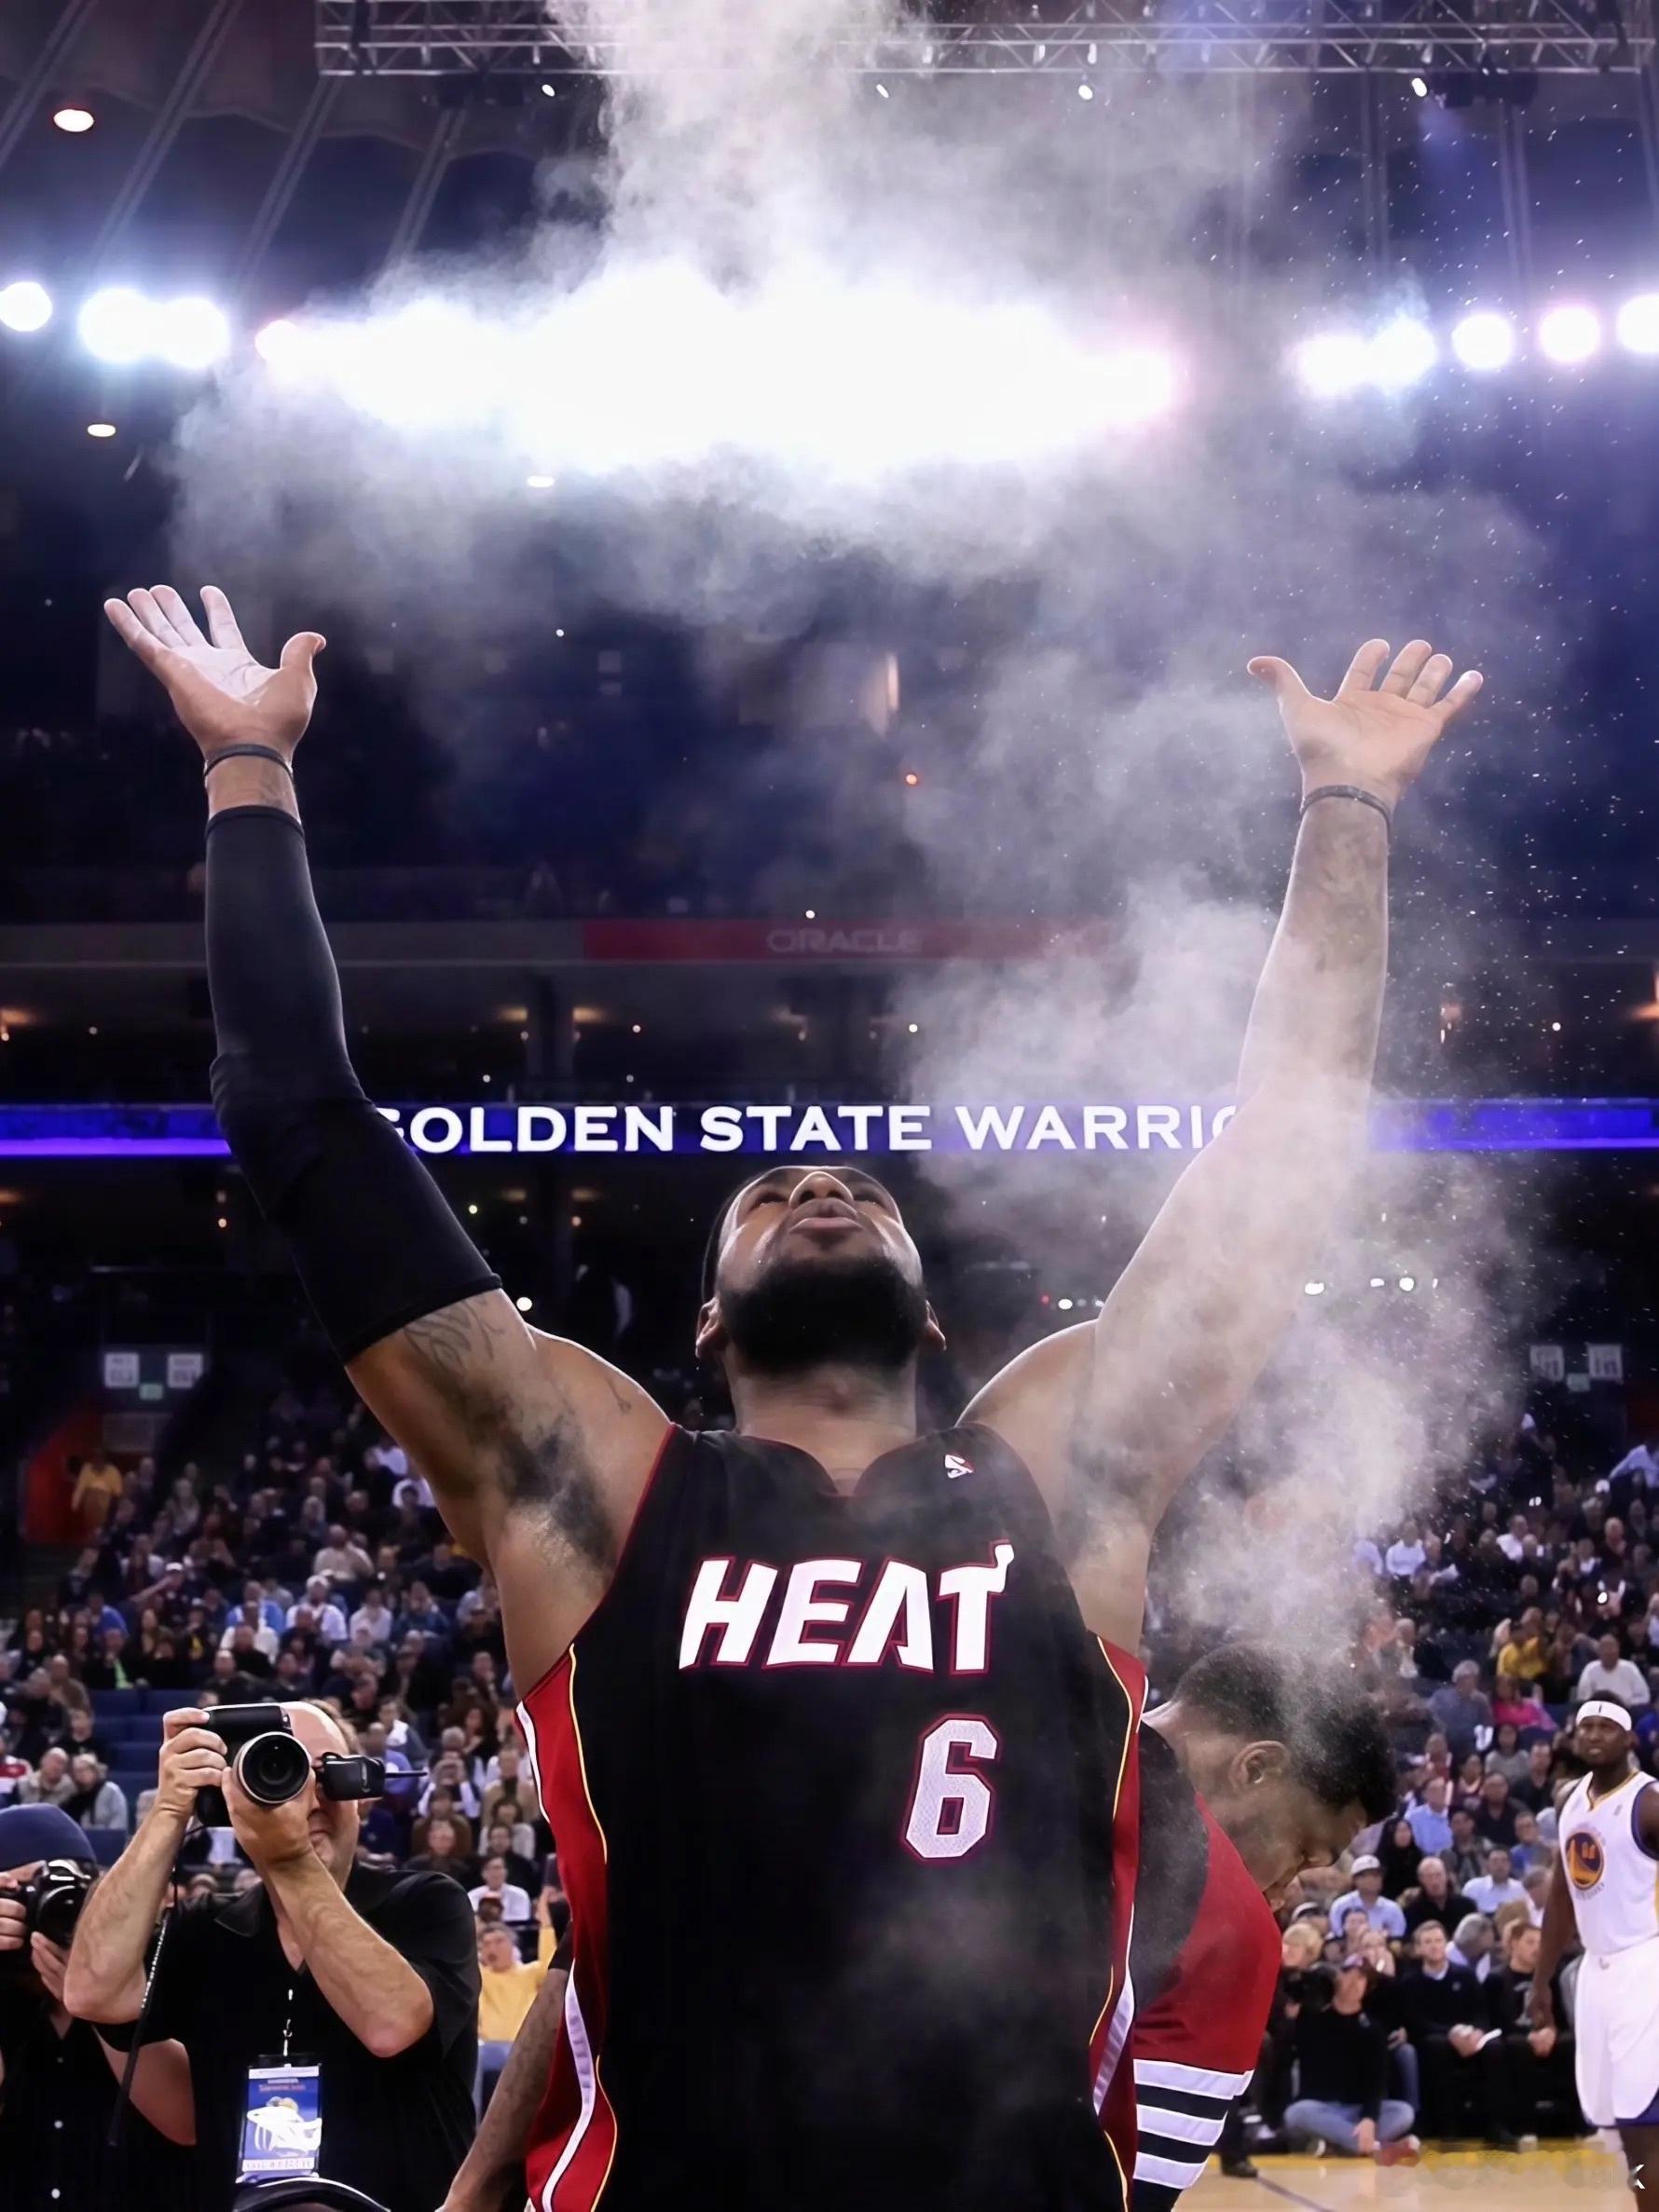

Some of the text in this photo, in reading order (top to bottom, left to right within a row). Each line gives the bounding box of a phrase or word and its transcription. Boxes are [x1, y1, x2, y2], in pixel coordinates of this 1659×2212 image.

[766, 929, 923, 954] ORACLE
[700, 1105, 932, 1153] STATE
[678, 1540, 1015, 1673] HEAT
[902, 1716, 1000, 1861] 6
